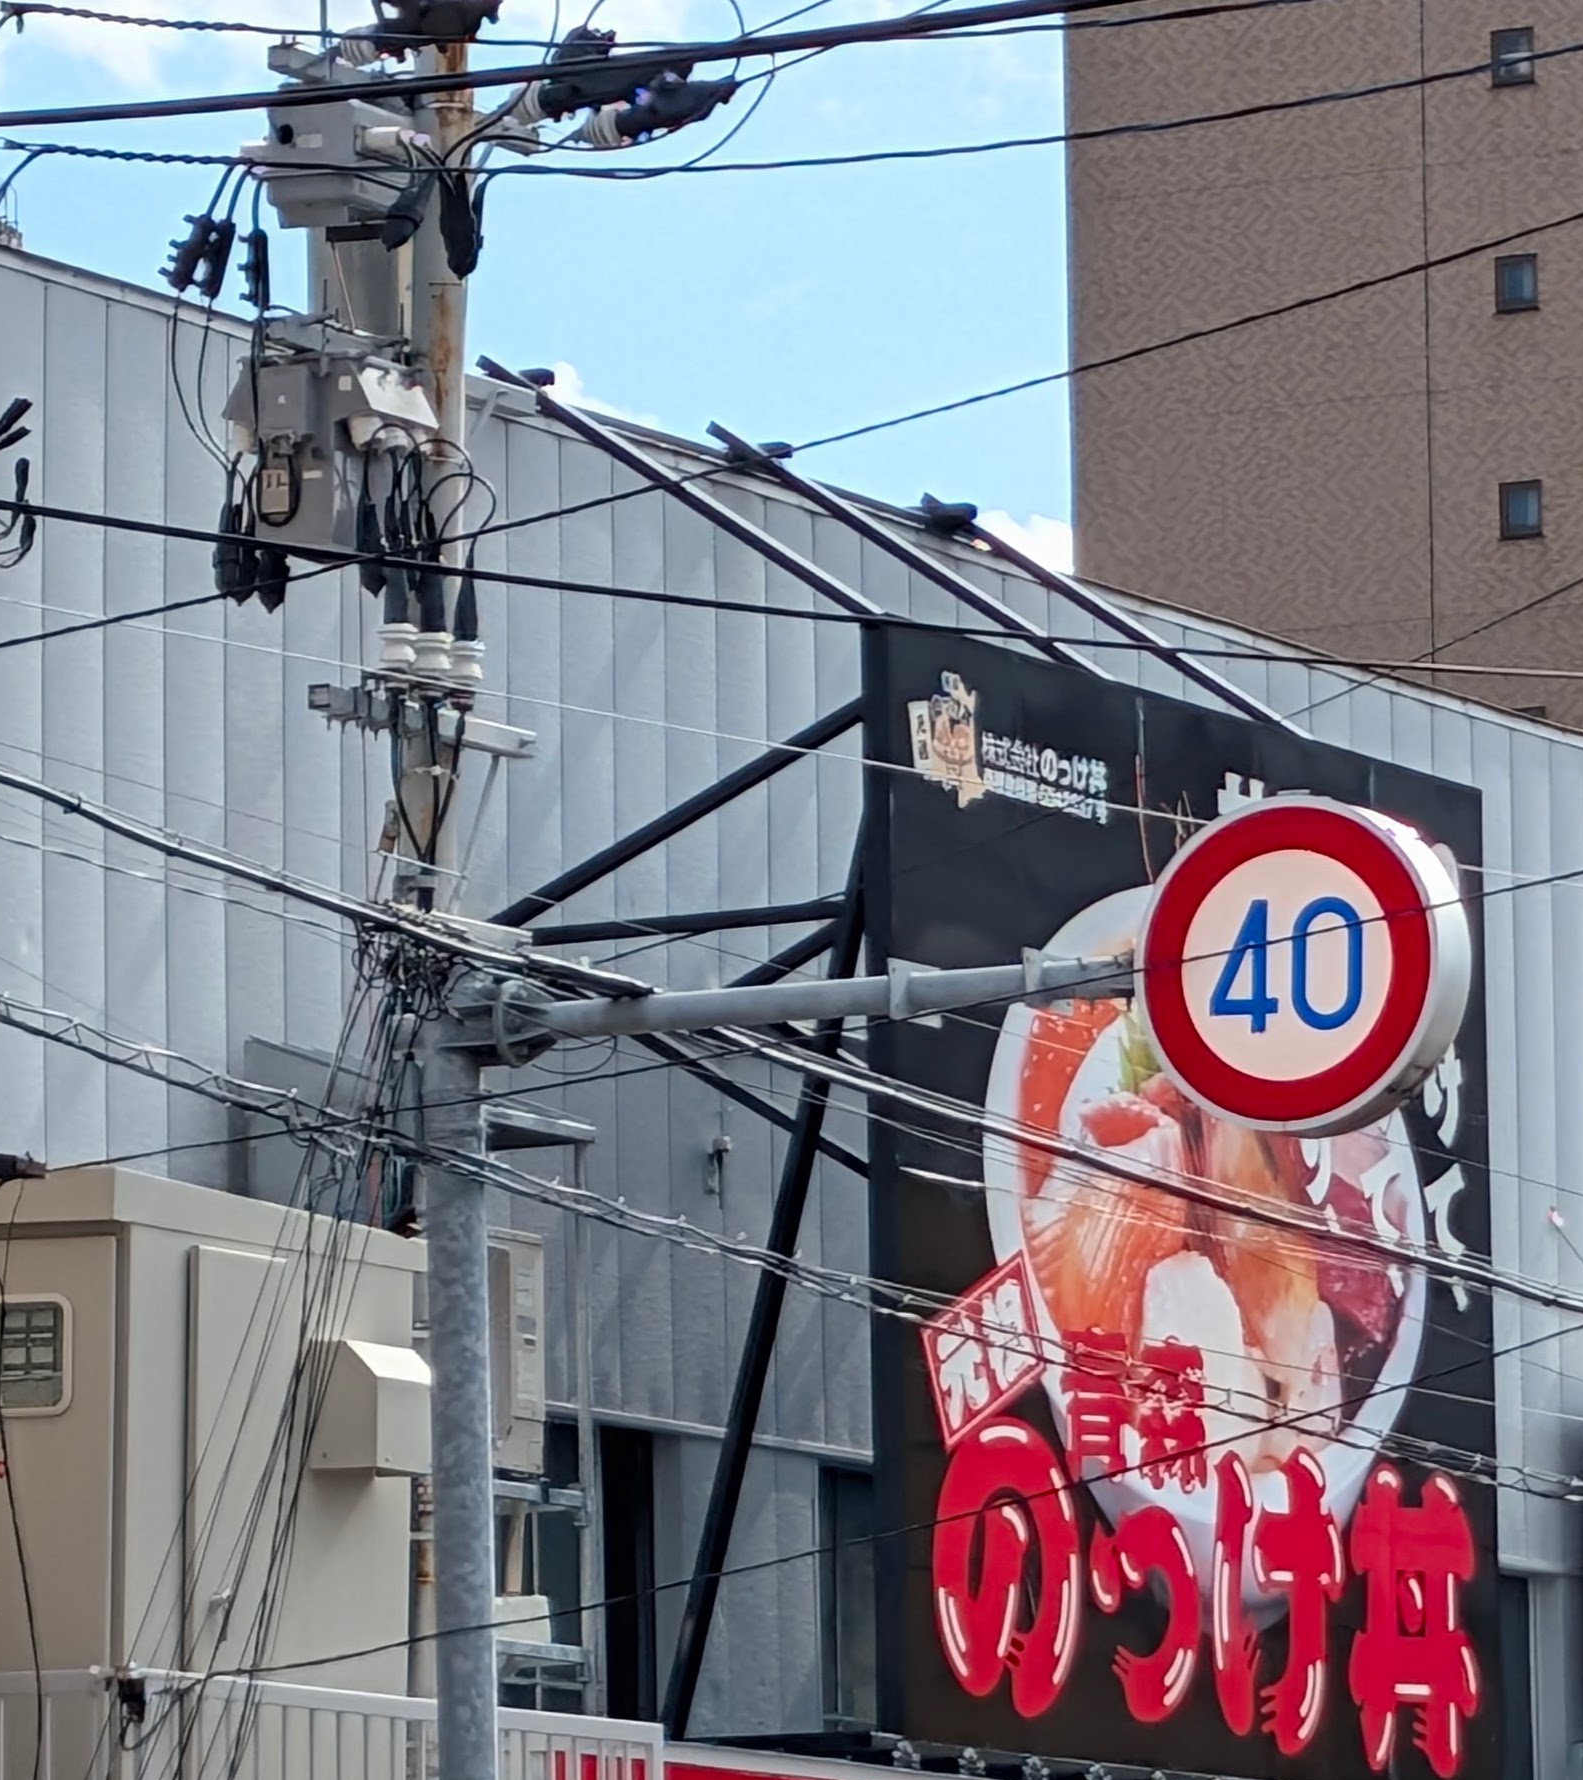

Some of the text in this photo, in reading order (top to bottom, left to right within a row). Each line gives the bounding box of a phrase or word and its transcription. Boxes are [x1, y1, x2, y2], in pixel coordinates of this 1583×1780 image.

[1209, 896, 1363, 1034] 40
[932, 1416, 1480, 1780] のっけ丼
